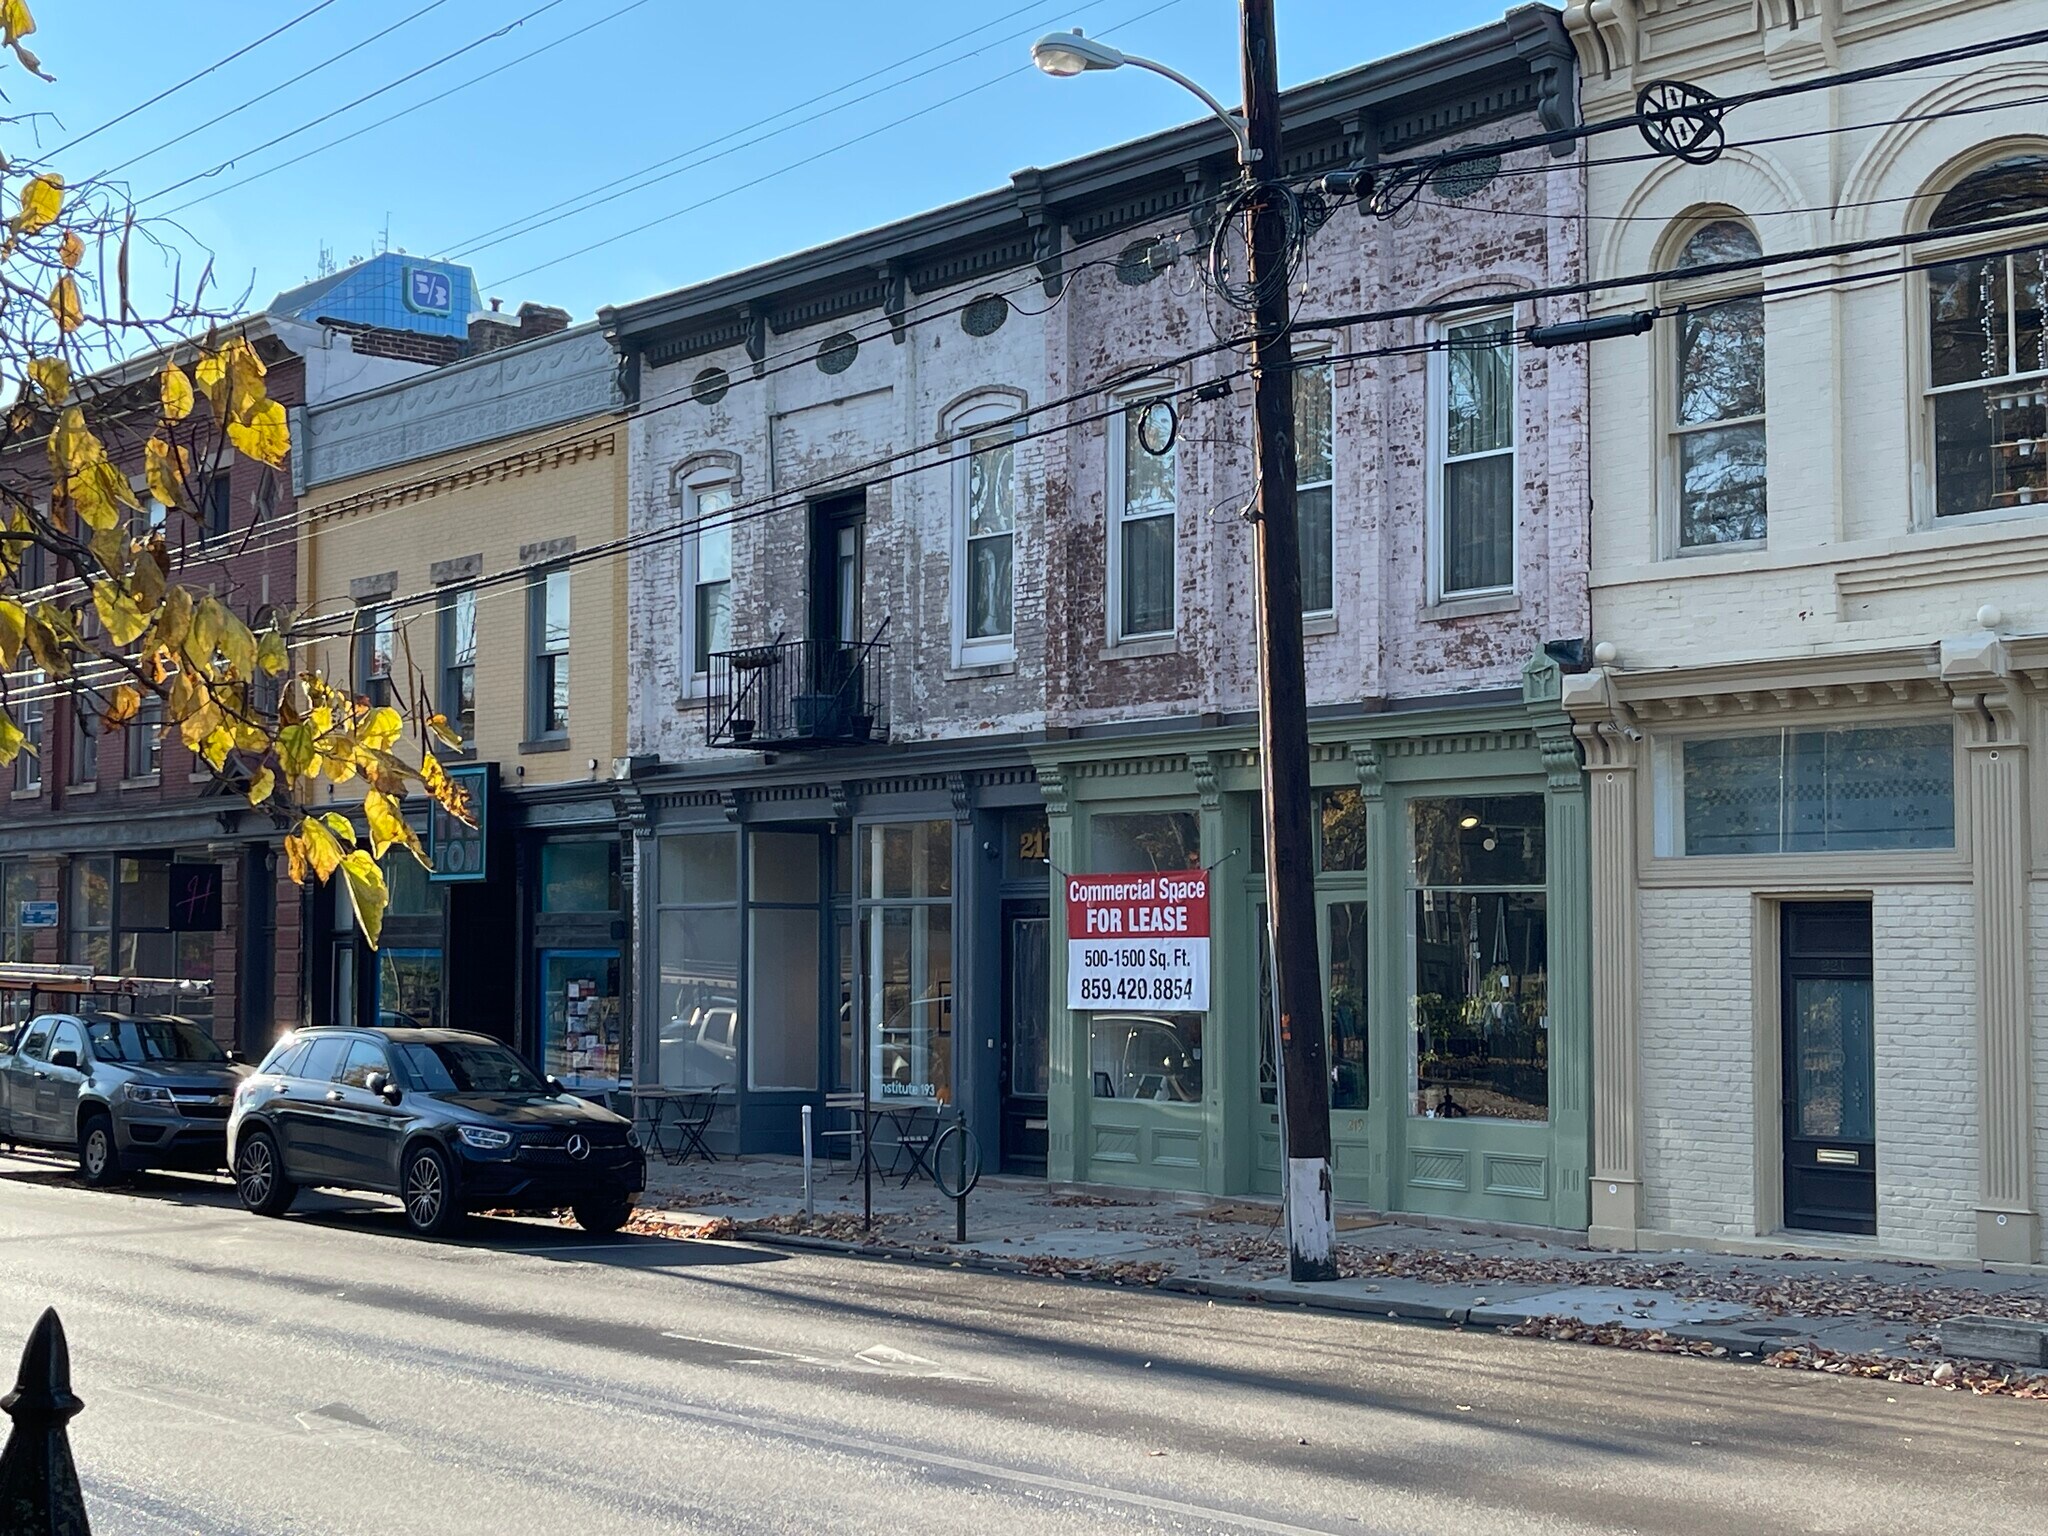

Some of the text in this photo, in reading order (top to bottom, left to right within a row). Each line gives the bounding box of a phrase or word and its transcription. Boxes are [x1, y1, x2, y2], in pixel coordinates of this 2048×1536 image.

[435, 840, 481, 873] TON
[1020, 831, 1050, 858] 21
[1069, 877, 1206, 903] Commercial Space
[1086, 906, 1188, 933] FOR LEASE
[1084, 948, 1191, 971] 500-1500 Sq. Ft.
[1081, 977, 1193, 1000] 859.420.8854
[920, 1083, 936, 1097] 193
